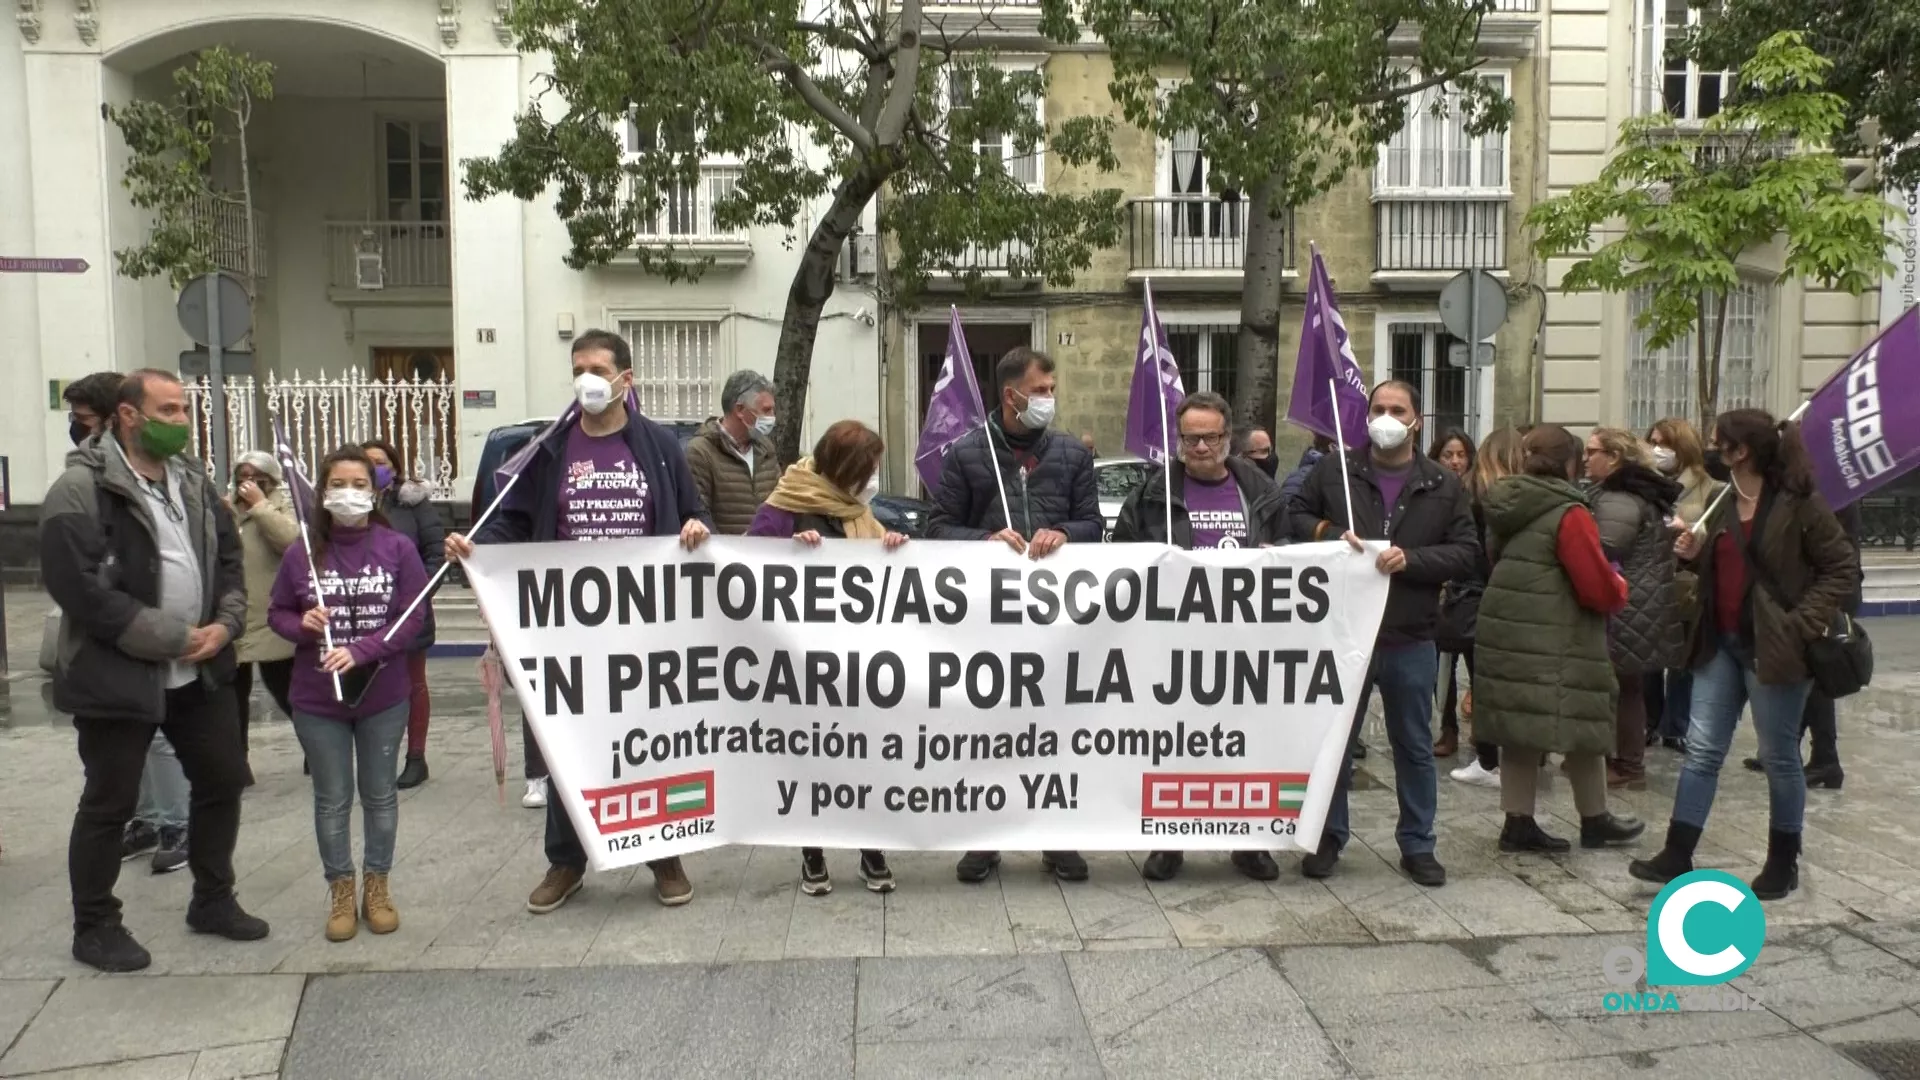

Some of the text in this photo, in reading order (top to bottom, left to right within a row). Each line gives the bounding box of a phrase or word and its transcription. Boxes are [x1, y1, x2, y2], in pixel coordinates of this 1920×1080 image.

[478, 328, 494, 343] 18
[1058, 333, 1072, 345] 17
[568, 498, 644, 510] EN PRECARIO
[566, 511, 646, 523] POR LA JUNTA
[1189, 511, 1233, 521] CCOO
[517, 562, 1330, 628] MONITORES/AS ESCOLARES
[608, 646, 906, 713] PRECARIO
[929, 650, 1045, 709] POR
[1064, 649, 1134, 703] LA
[1152, 649, 1344, 705] JUNTA
[611, 719, 1246, 778] ¡Contratación a jornada completa
[777, 772, 1079, 816] y por centro YA!
[1151, 781, 1271, 809] CCOO
[661, 817, 715, 842] Cádiz
[1141, 817, 1250, 835] Enseñanza
